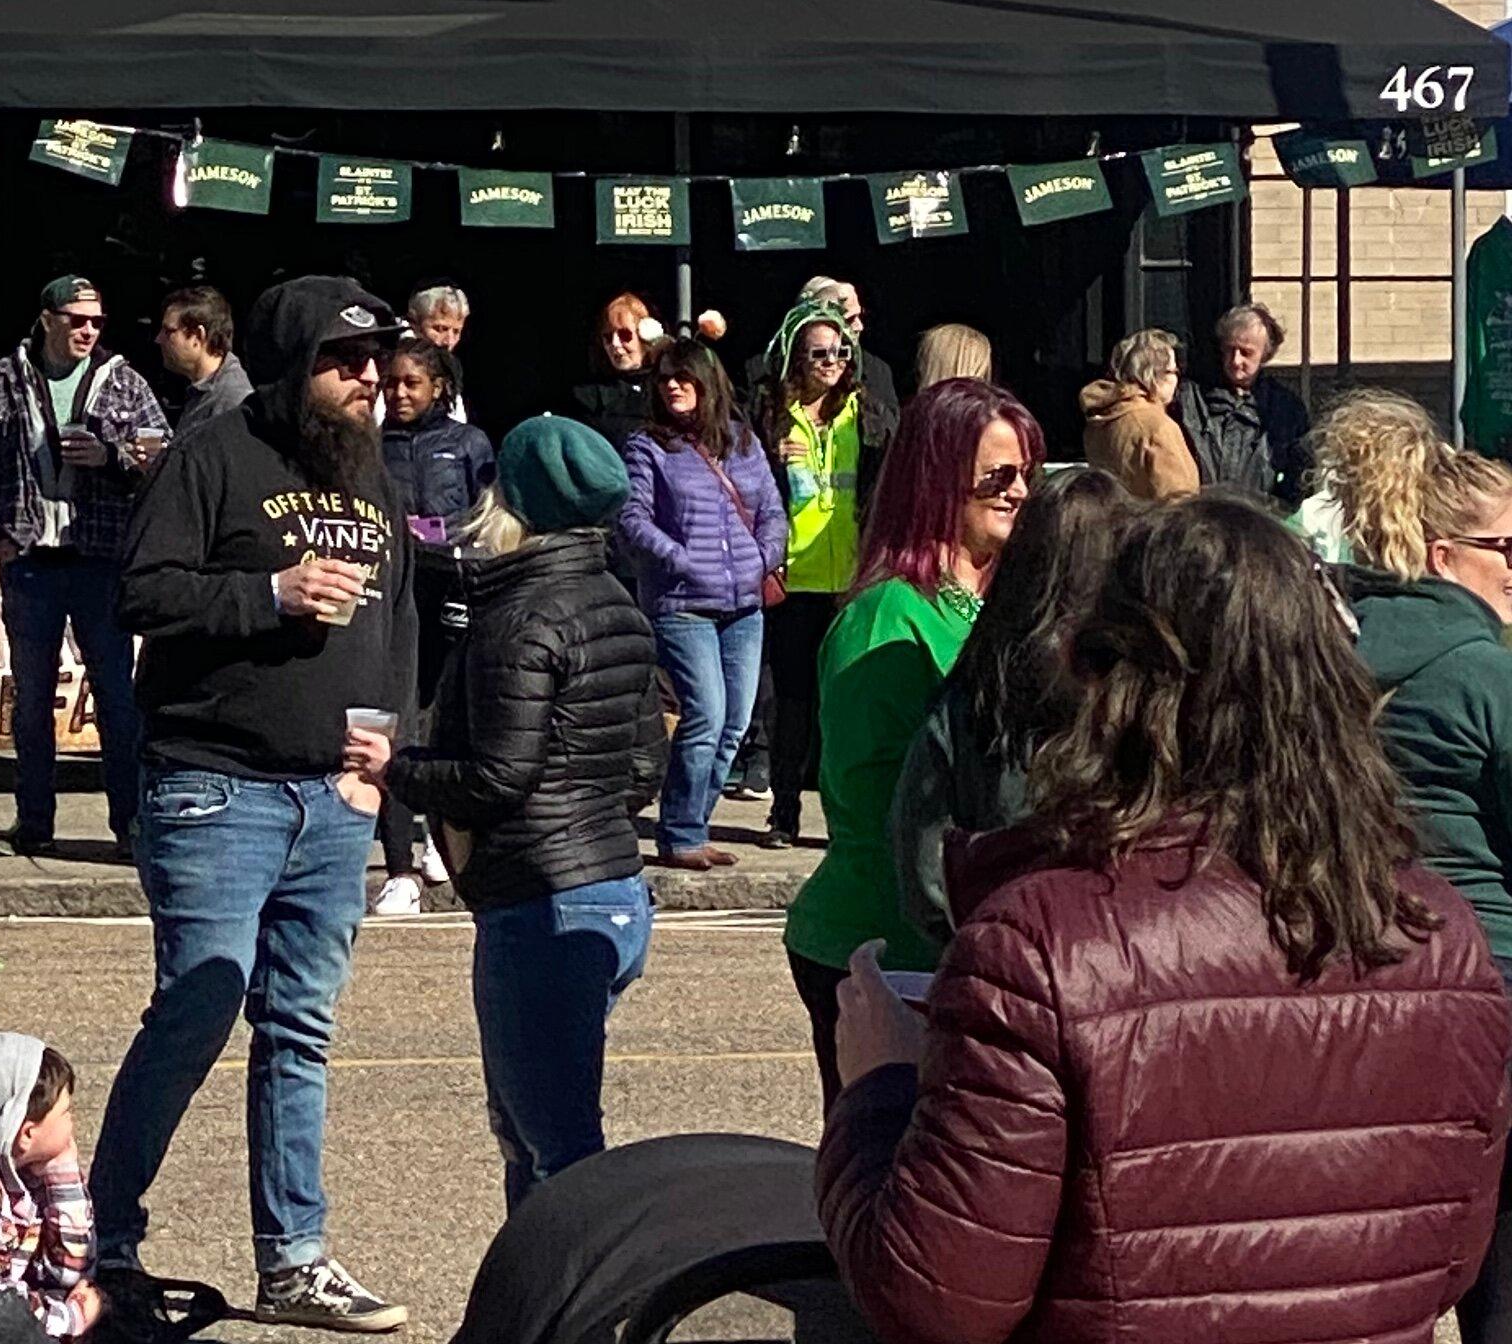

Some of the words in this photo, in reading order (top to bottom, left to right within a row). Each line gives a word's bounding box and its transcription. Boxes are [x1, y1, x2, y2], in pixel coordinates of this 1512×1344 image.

[1379, 65, 1474, 112] 467
[1424, 117, 1475, 137] LUCK
[1427, 134, 1479, 157] IRISH
[1291, 148, 1359, 174] JAMESON
[188, 165, 260, 189] JAMESON
[470, 186, 543, 206] JAMESON
[1024, 176, 1095, 204] JAMESON
[614, 196, 669, 209] LUCK
[615, 213, 672, 228] IRISH
[742, 204, 814, 226] JAMESON
[262, 492, 299, 519] OFF
[298, 515, 380, 552] VANS
